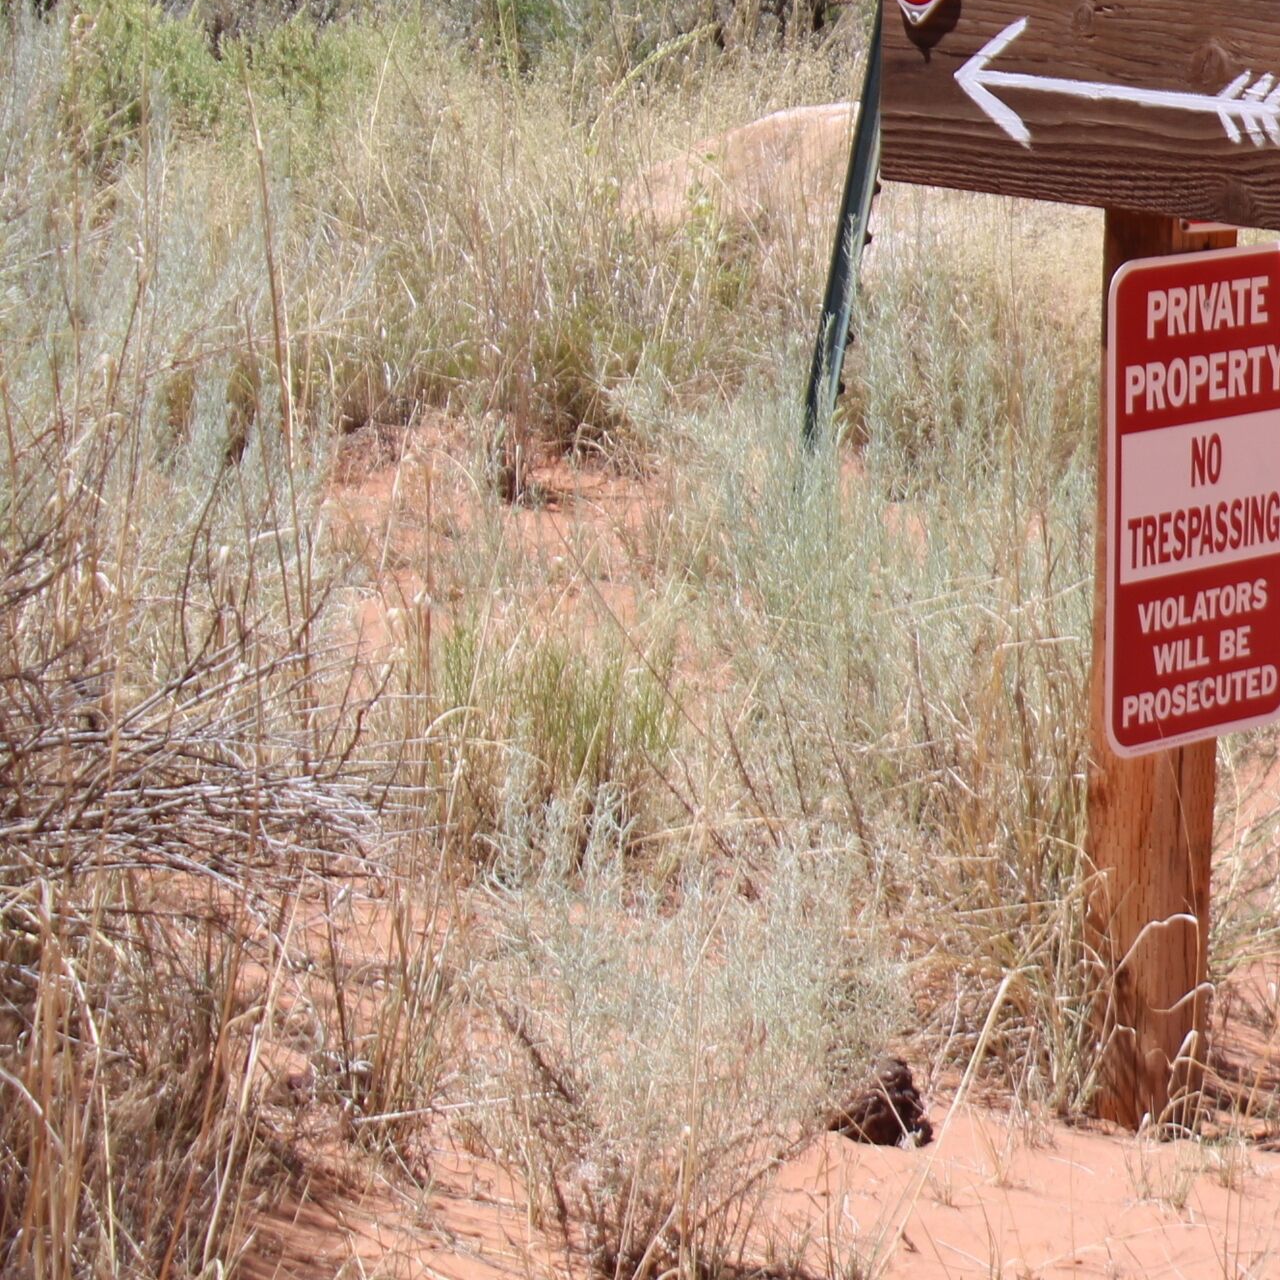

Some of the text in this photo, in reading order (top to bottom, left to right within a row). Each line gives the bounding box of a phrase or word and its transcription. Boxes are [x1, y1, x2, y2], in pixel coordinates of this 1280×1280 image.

[1147, 275, 1269, 339] PRIVATE
[1191, 432, 1222, 487] NO
[1128, 491, 1280, 569] TRESPASSING
[1137, 578, 1268, 634] VIOLATORS
[1153, 625, 1251, 676] WILL BE
[1122, 664, 1278, 728] PROSECUTED
